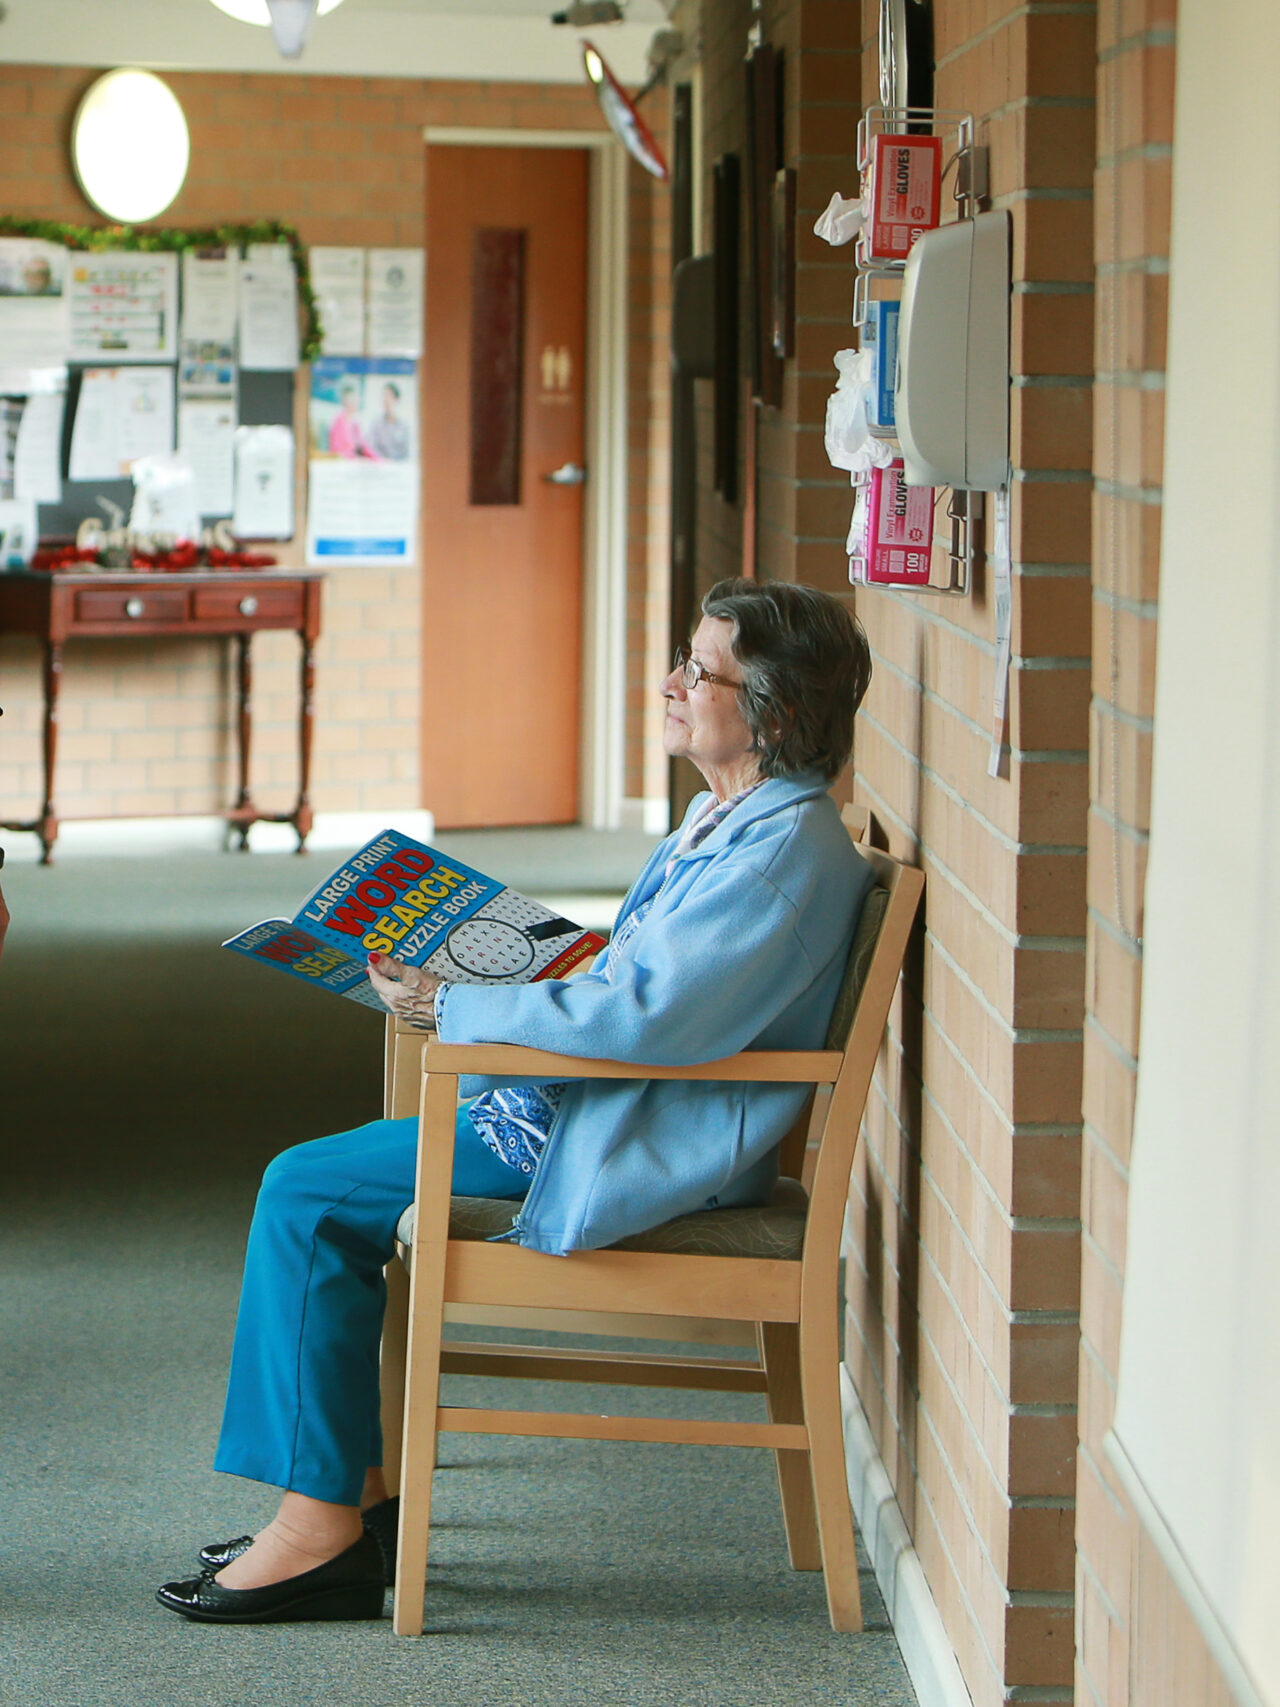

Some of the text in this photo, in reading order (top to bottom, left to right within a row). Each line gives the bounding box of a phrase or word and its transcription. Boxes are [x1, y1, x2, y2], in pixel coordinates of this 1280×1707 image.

[886, 148, 897, 218] Vinyl Examination
[896, 148, 911, 195] GLOVES
[882, 225, 890, 250] LARGE
[885, 470, 897, 539] Vinyl Examination
[894, 471, 908, 517] GLOVES
[881, 549, 889, 572] SMALL
[906, 552, 919, 573] 100
[304, 836, 398, 923] LARGE PRINT
[324, 848, 435, 937] WORD
[442, 880, 489, 916] BOOK
[362, 865, 468, 955] SEARCH
[235, 927, 278, 950] LARGE
